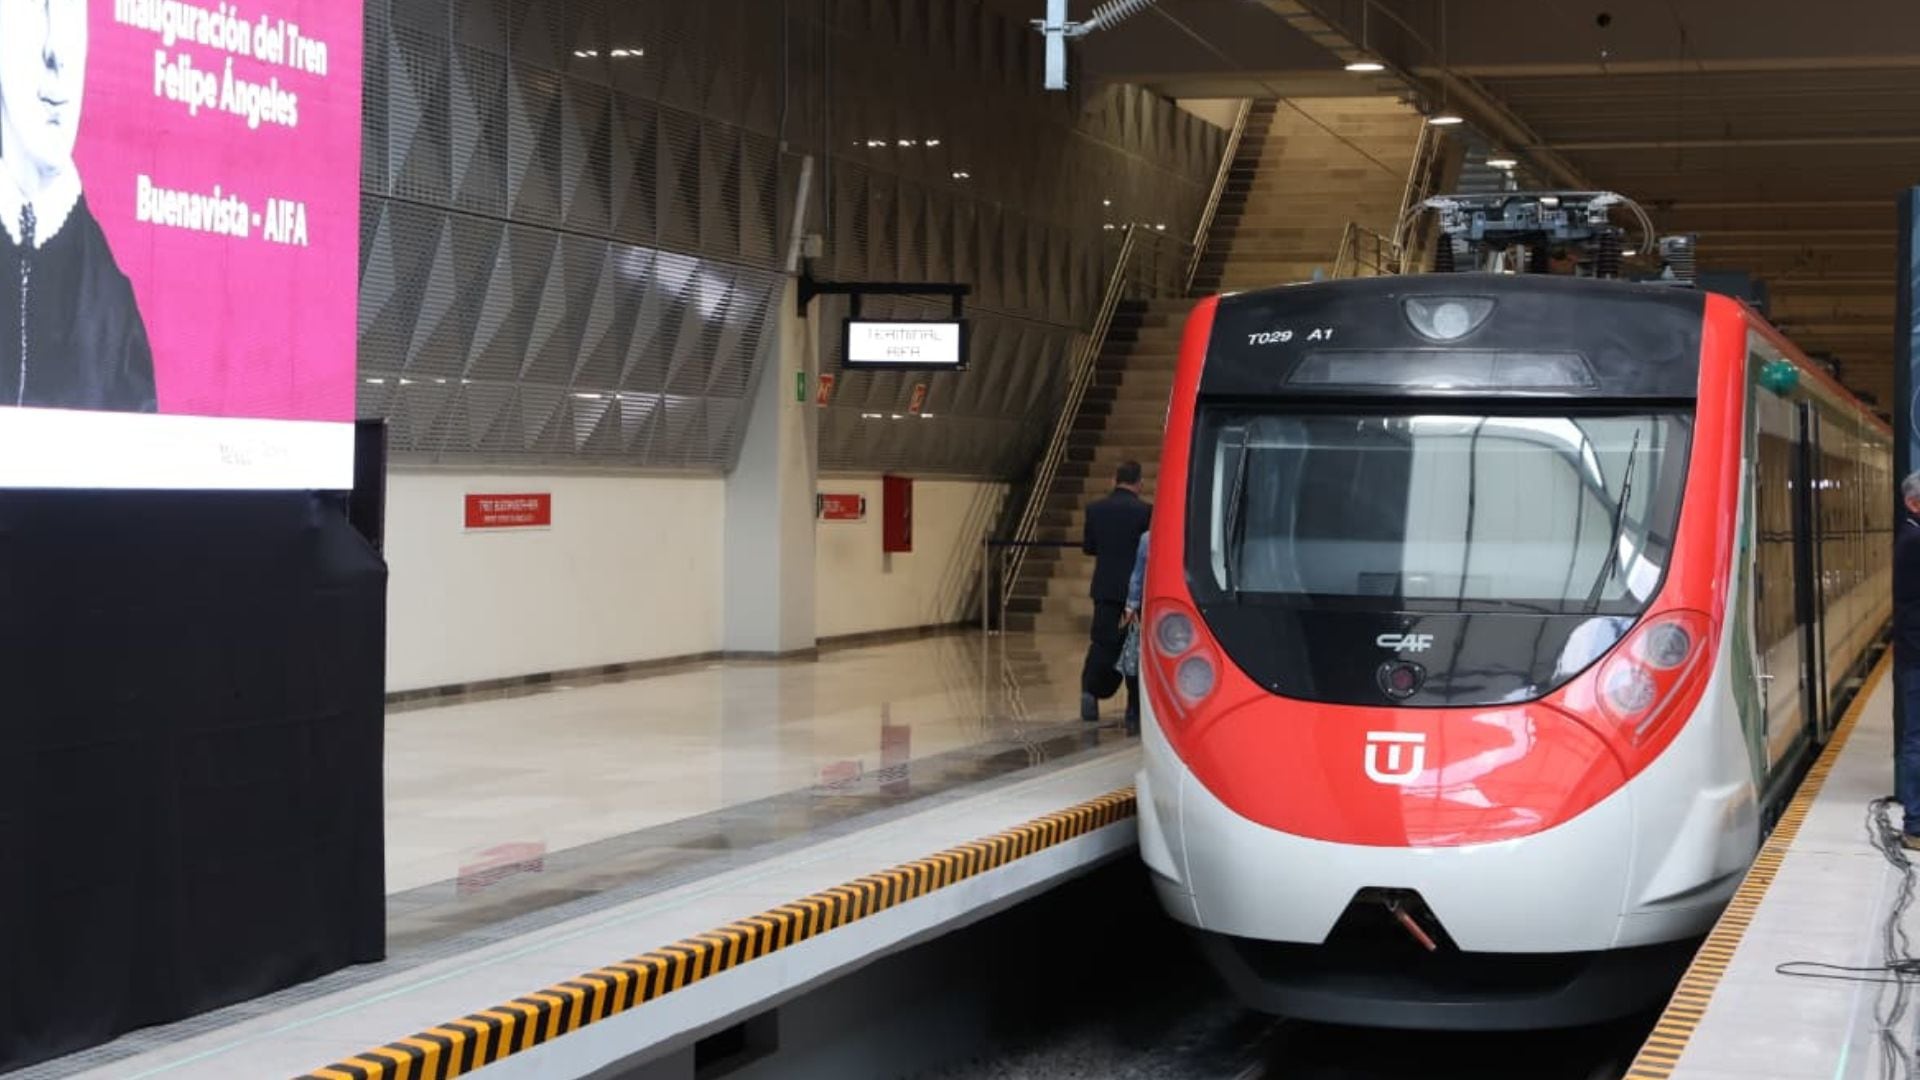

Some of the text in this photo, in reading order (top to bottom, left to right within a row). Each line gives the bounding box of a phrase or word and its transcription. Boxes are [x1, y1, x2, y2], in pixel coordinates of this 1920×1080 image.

[253, 14, 284, 64] del
[286, 22, 327, 76] Tren
[154, 49, 298, 129] Felipe Ángeles
[136, 174, 249, 237] Buenavista
[263, 197, 308, 246] AIFA
[1248, 327, 1333, 346] T029 A1
[1376, 634, 1434, 652] CAF
